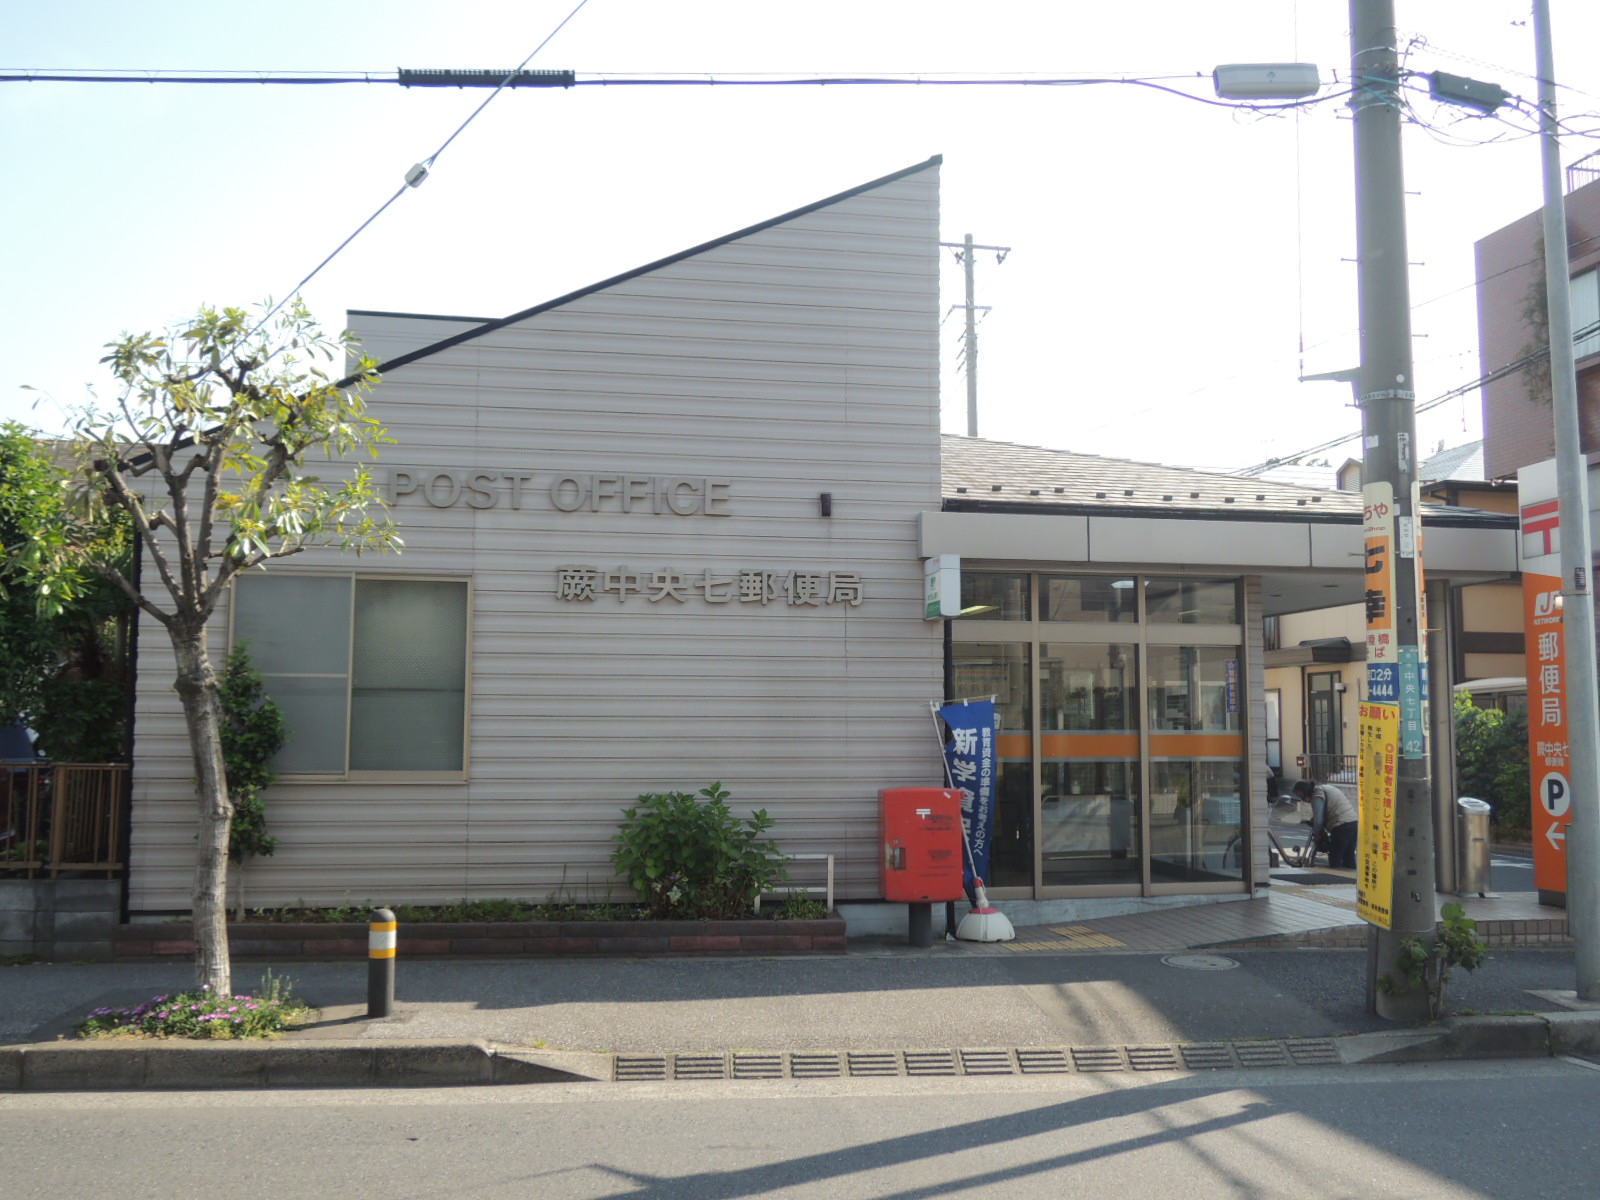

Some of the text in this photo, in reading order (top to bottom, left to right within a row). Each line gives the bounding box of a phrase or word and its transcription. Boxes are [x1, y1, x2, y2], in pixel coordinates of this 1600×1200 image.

[389, 472, 732, 517] POST OFFICE
[556, 563, 865, 607] 蕨中央七郵便局
[1538, 632, 1562, 727] 郵便局
[1359, 704, 1396, 720] お願い
[1406, 740, 1421, 753] 42
[1548, 778, 1564, 810] P
